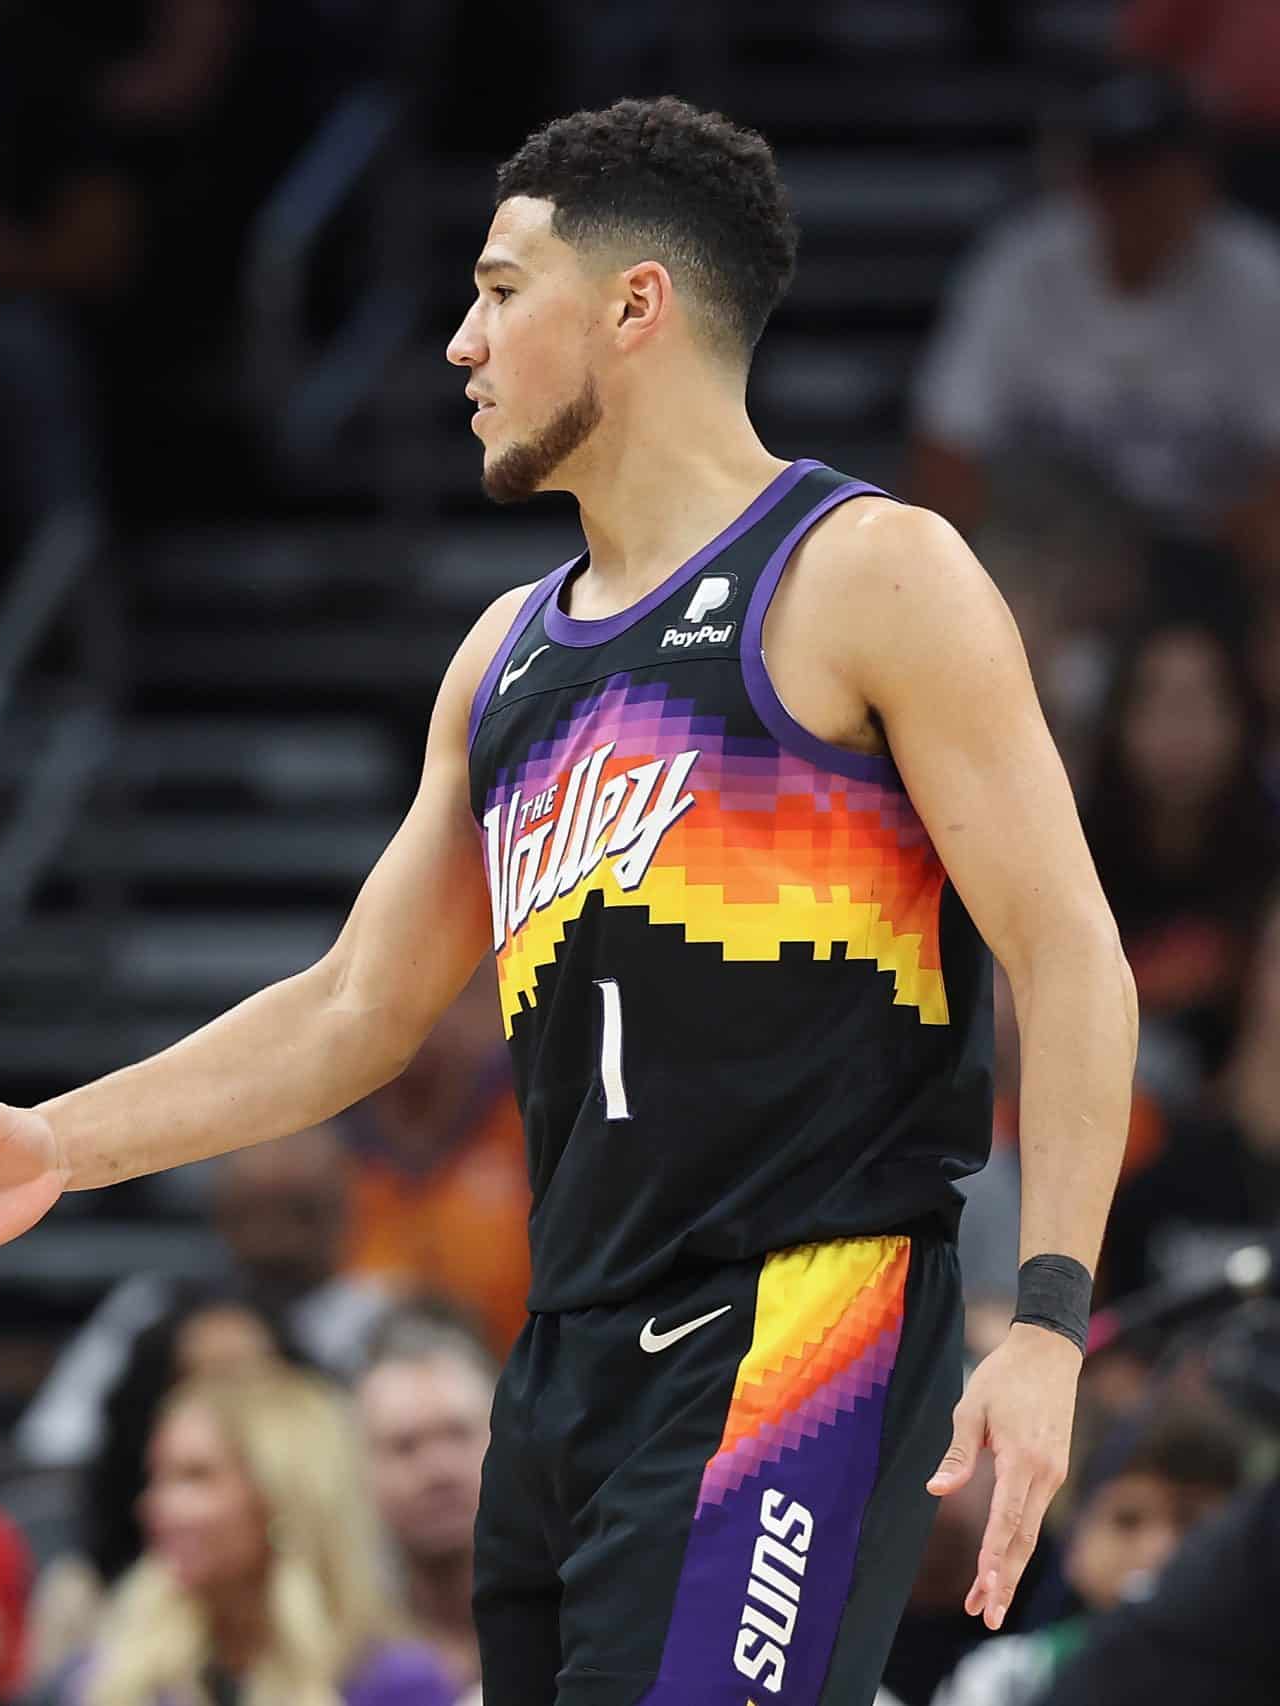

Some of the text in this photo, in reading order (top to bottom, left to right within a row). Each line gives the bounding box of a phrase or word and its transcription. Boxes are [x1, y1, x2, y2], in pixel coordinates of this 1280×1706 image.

[660, 625, 732, 648] PayPal
[483, 742, 700, 953] Valley
[519, 784, 559, 829] THE
[594, 979, 630, 1120] 1
[733, 1488, 814, 1693] SUNS
